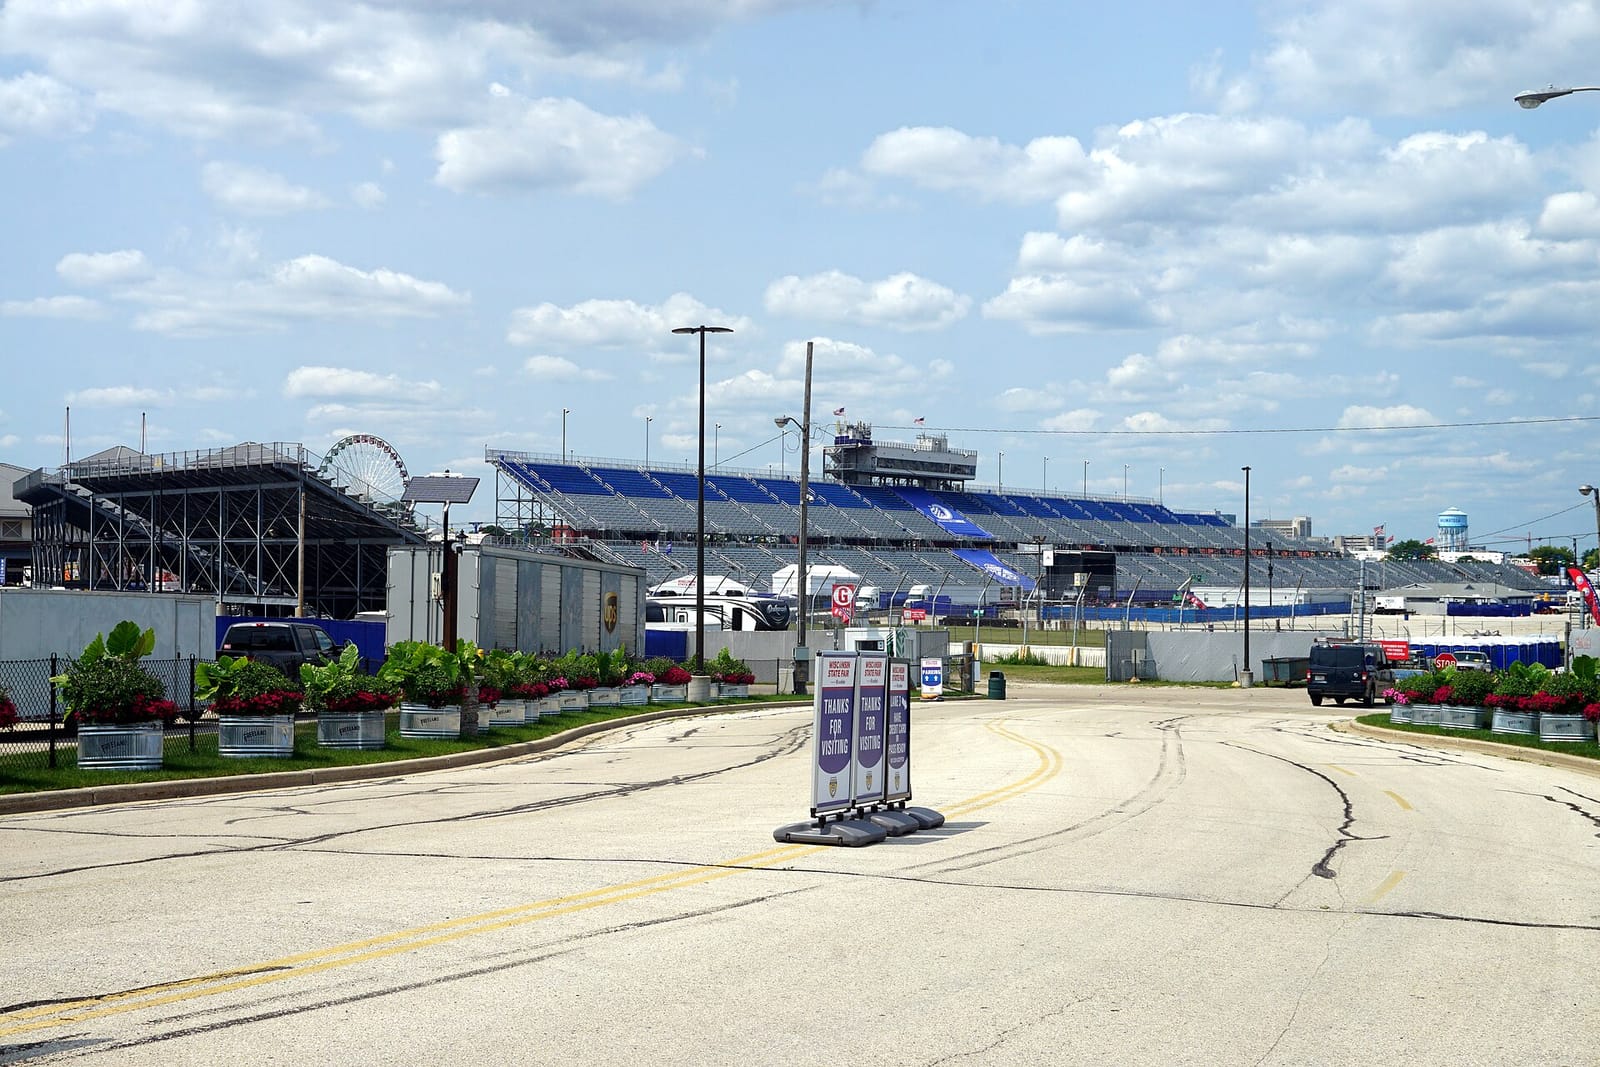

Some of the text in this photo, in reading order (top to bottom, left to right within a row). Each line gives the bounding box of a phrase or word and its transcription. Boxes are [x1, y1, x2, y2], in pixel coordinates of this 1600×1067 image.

[840, 589, 848, 601] G
[604, 605, 617, 629] ups
[1436, 659, 1456, 669] STOP
[828, 669, 841, 677] STATE
[824, 698, 849, 714] THANKS
[861, 696, 881, 711] THANKS
[829, 719, 842, 734] FOR
[865, 716, 875, 731] FOR
[821, 739, 848, 755] VISITING
[859, 735, 881, 750] VISITING
